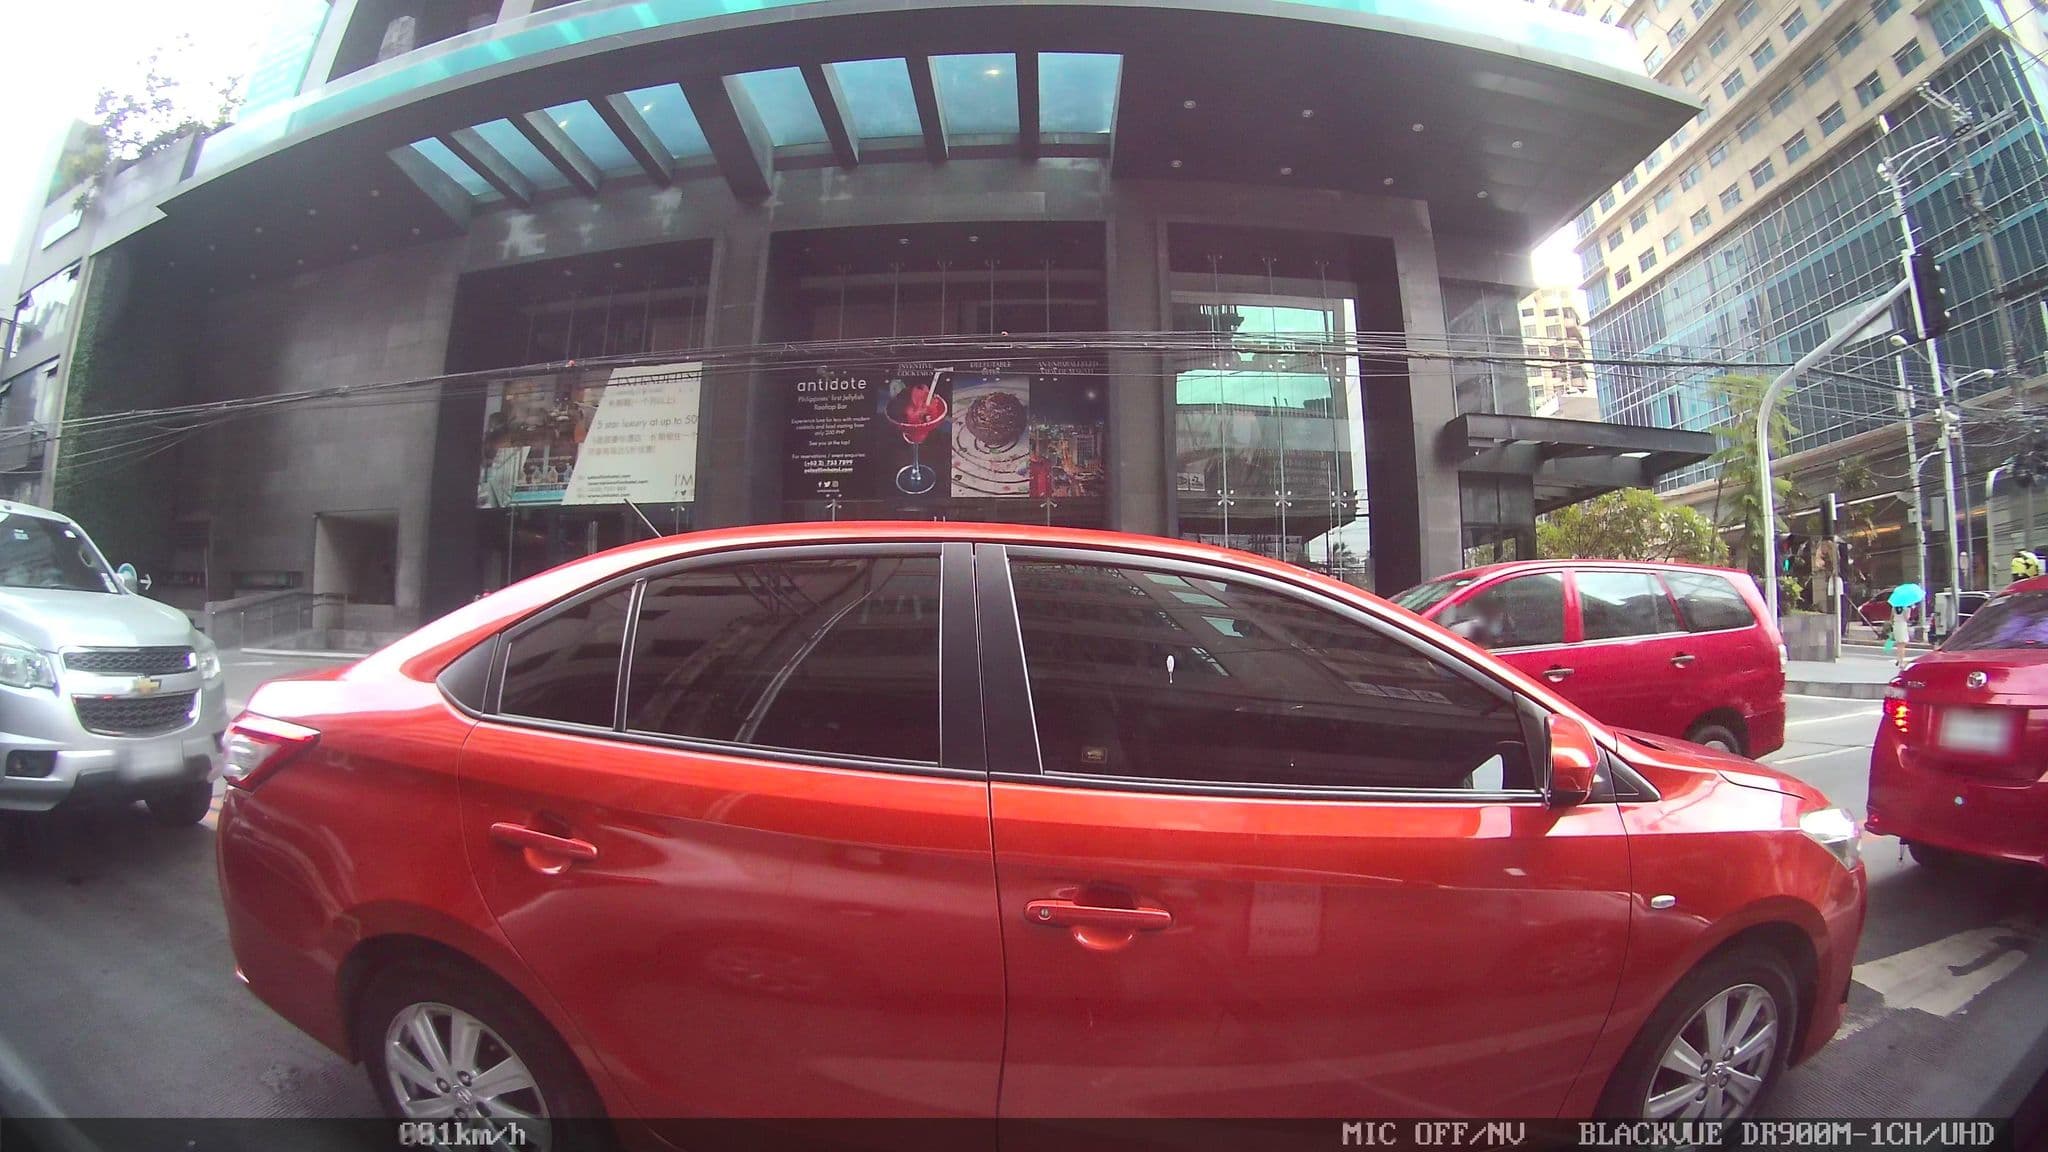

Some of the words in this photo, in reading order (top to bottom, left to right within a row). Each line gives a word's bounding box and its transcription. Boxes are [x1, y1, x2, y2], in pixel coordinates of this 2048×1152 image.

[797, 377, 867, 392] antidote
[660, 416, 671, 427] up
[673, 415, 682, 425] to
